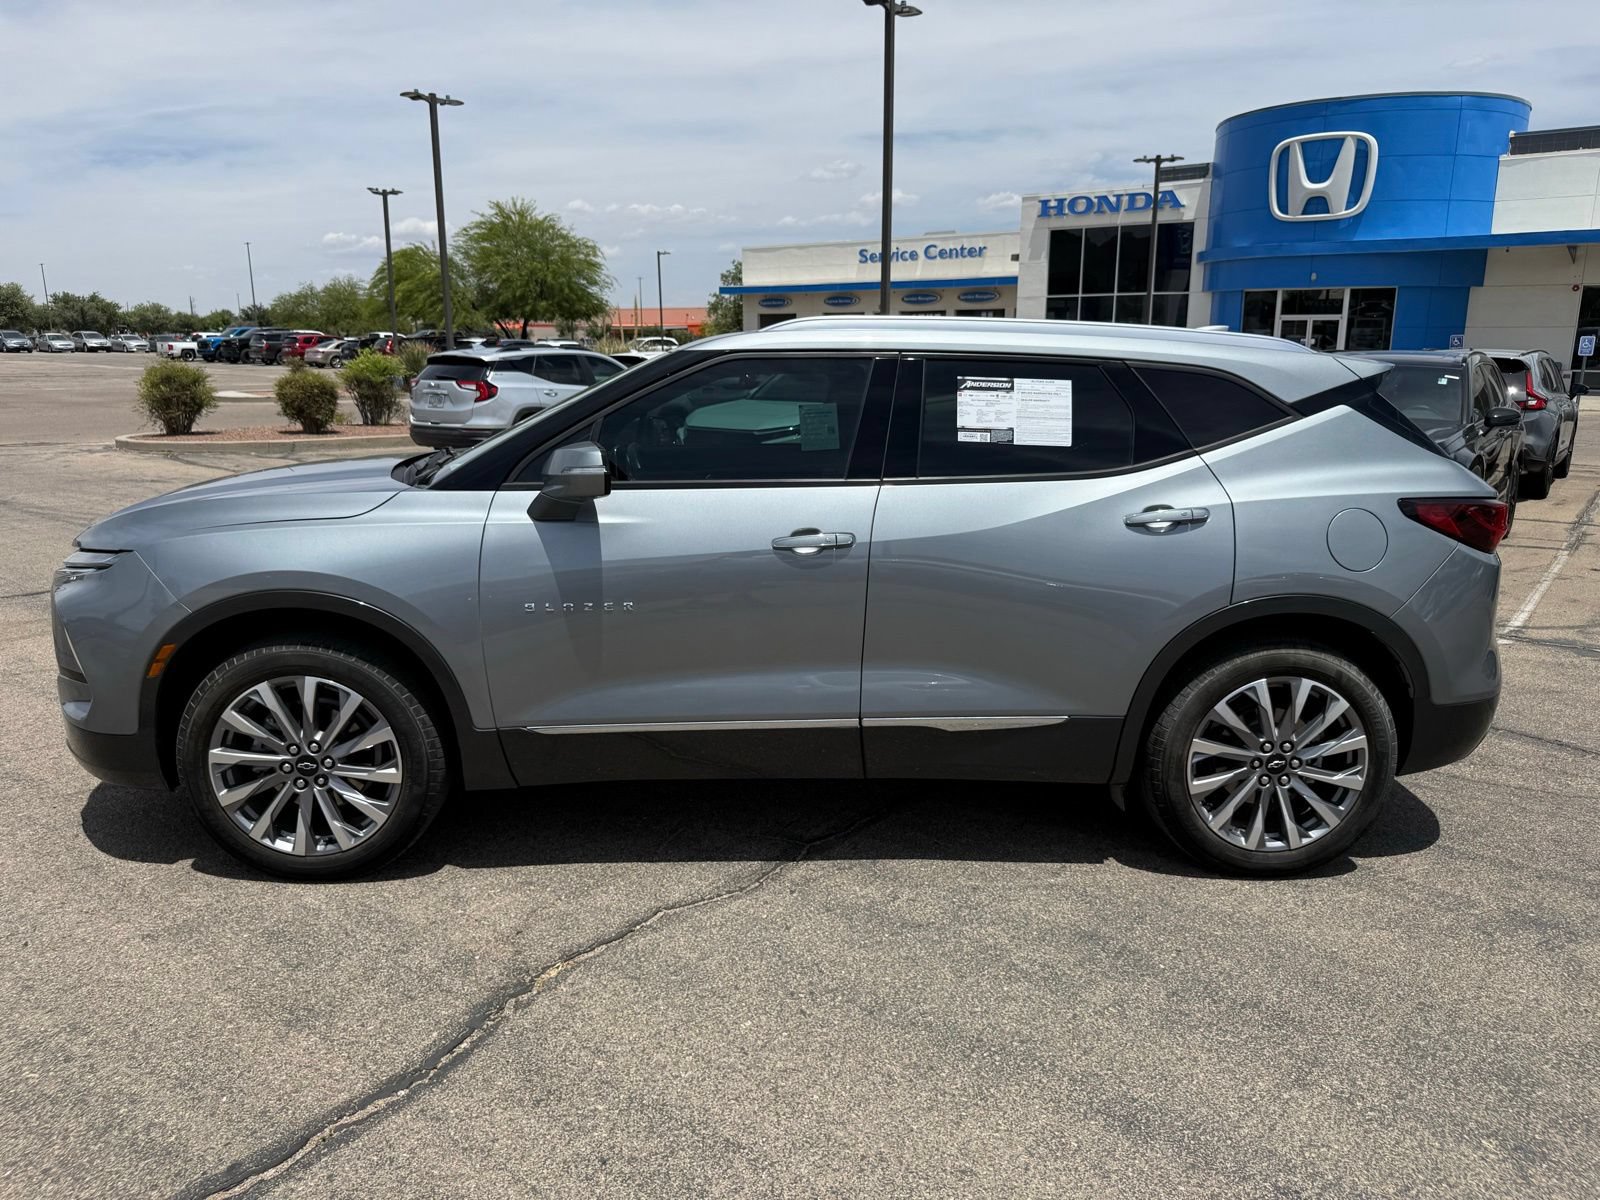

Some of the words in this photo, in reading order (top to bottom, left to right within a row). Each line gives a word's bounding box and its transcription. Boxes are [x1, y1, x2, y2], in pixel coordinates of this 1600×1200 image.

[1038, 190, 1185, 218] HONDA
[924, 244, 987, 260] Center
[524, 602, 634, 612] BLAZER
